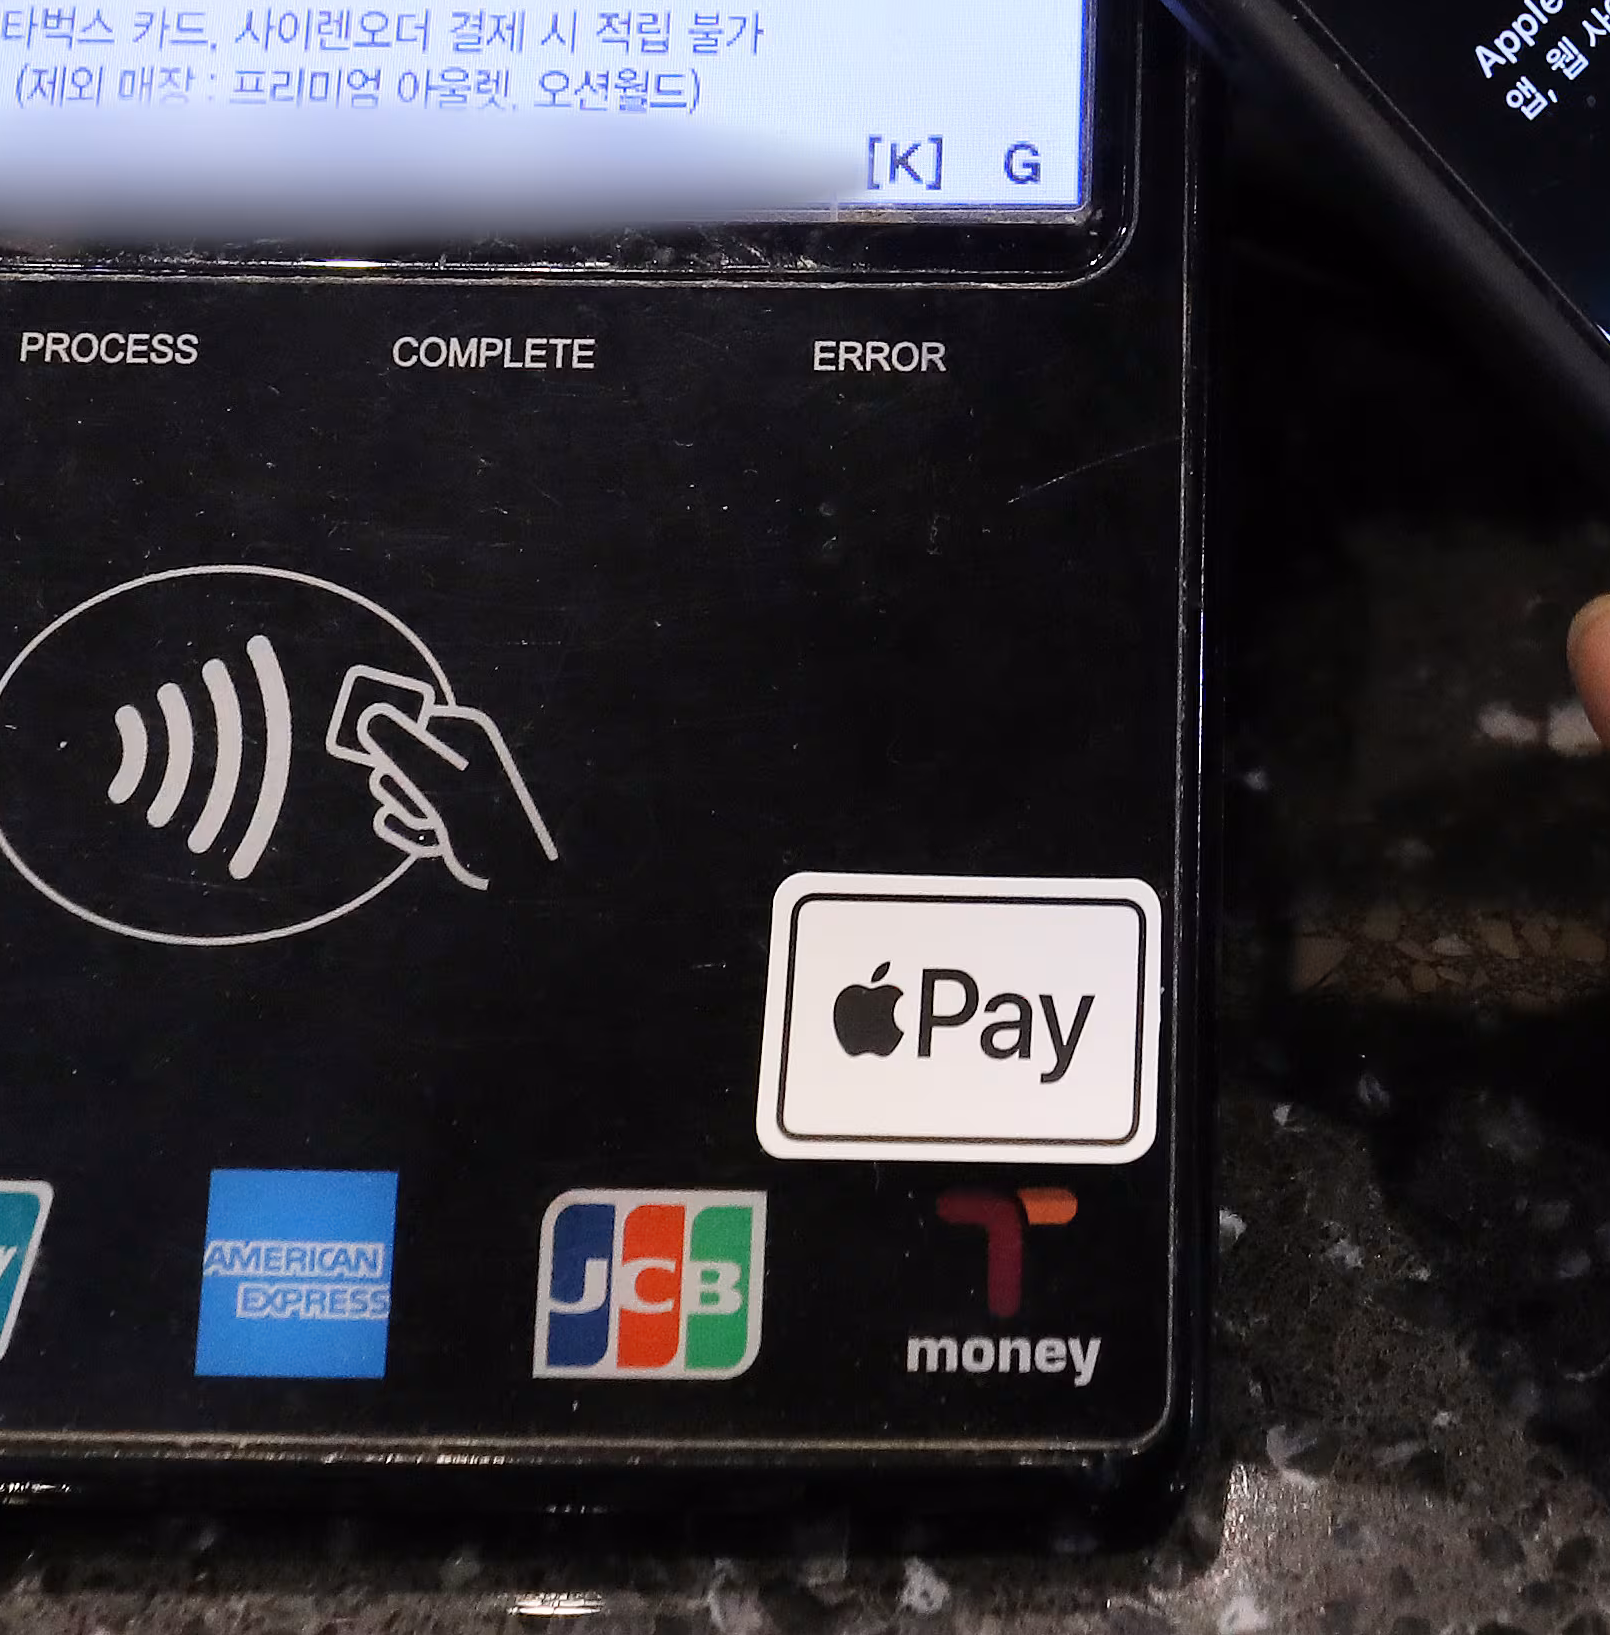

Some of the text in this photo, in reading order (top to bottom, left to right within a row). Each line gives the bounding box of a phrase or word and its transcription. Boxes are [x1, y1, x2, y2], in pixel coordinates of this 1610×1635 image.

[133, 6, 217, 51] 카드,
[235, 7, 431, 53] 사이렌오더
[450, 9, 525, 54] 결제
[541, 10, 578, 54] 시
[596, 10, 672, 55] 적립
[688, 11, 764, 55] 불가
[16, 64, 104, 108] (제외
[118, 65, 196, 106] 매장
[229, 68, 382, 108] 프리미엄
[534, 67, 701, 114] 오션월드)
[1505, 75, 1558, 121] 앱,
[1545, 35, 1590, 81] 웹
[867, 134, 1041, 190] [K] G
[20, 331, 198, 366] PROCESS
[393, 335, 595, 371] COMPLETE
[812, 338, 947, 373] ERROR
[916, 967, 1095, 1086] Pay
[204, 1241, 384, 1276] AMERICAN
[236, 1282, 390, 1318] EXPRESS
[544, 1259, 744, 1315] JCB
[906, 1335, 1101, 1386] money
